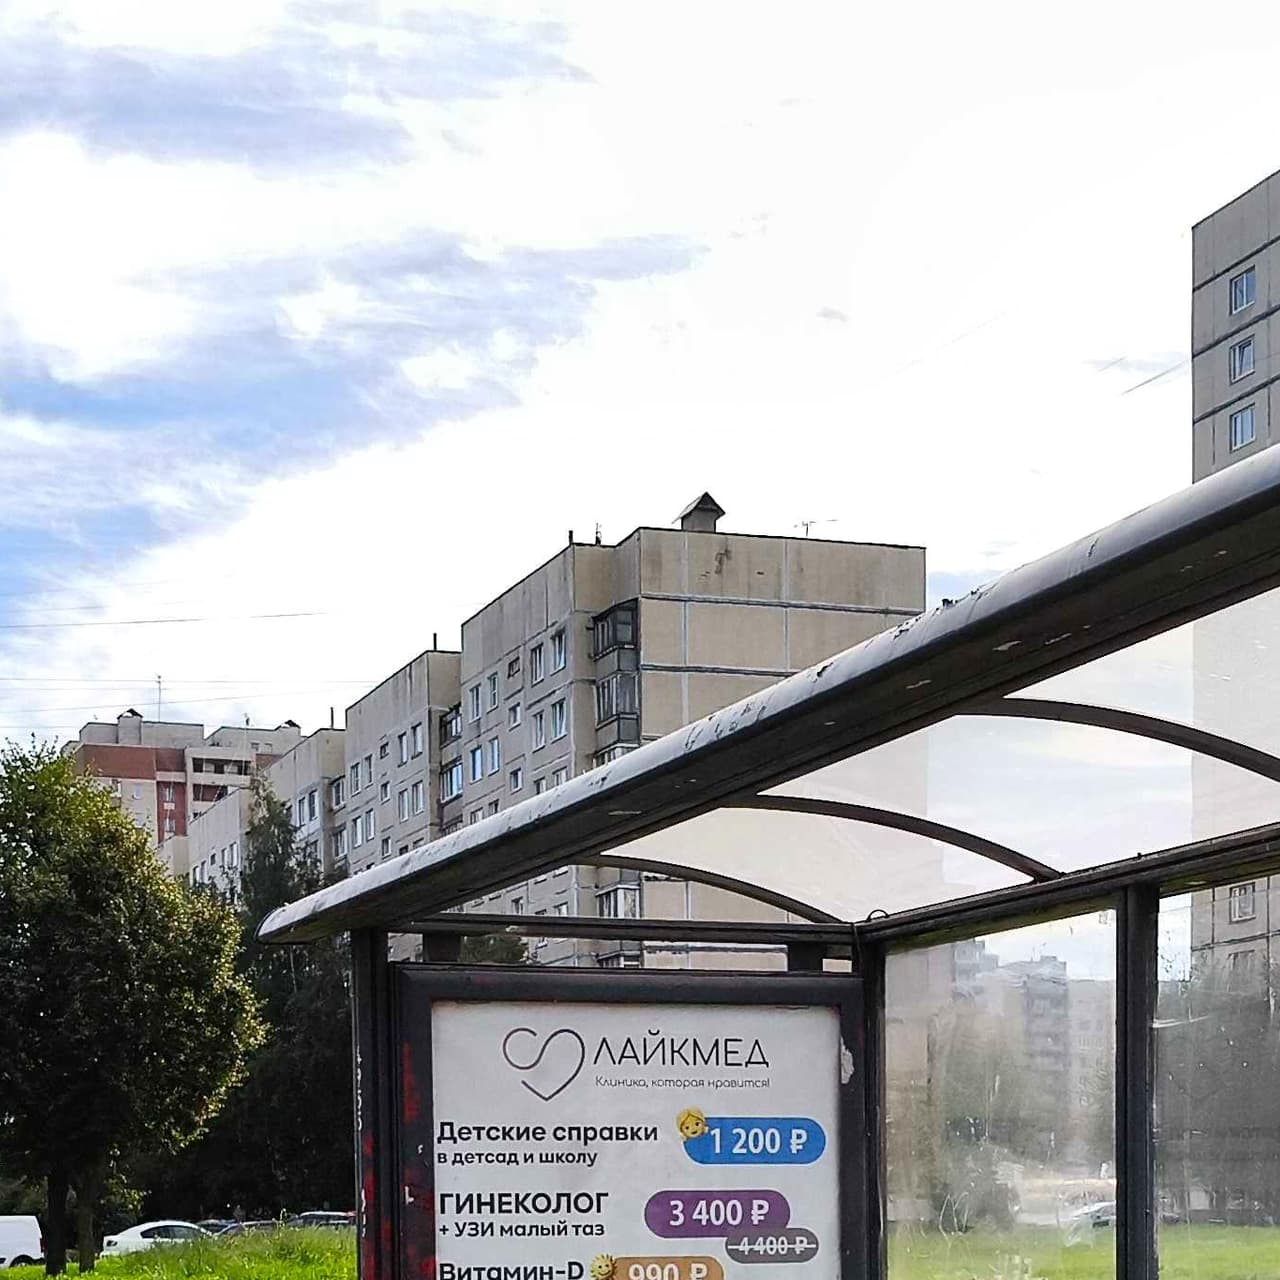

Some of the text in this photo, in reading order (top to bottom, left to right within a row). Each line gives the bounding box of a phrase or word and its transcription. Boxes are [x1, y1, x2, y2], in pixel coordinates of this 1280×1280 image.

[593, 1029, 769, 1068] ЛАЙКМЕД
[595, 1077, 770, 1090] Клиника, которая нравится!
[437, 1121, 658, 1146] Детские справки
[710, 1129, 721, 1154] 1
[732, 1128, 780, 1154] 200
[438, 1152, 598, 1167] в детсад и школу
[439, 1192, 609, 1215] ГИНЕКОЛОГ
[670, 1200, 684, 1226] 3
[692, 1200, 743, 1226] 400
[454, 1222, 494, 1237] УЗИ
[500, 1220, 568, 1236] малый
[572, 1224, 605, 1236] таз
